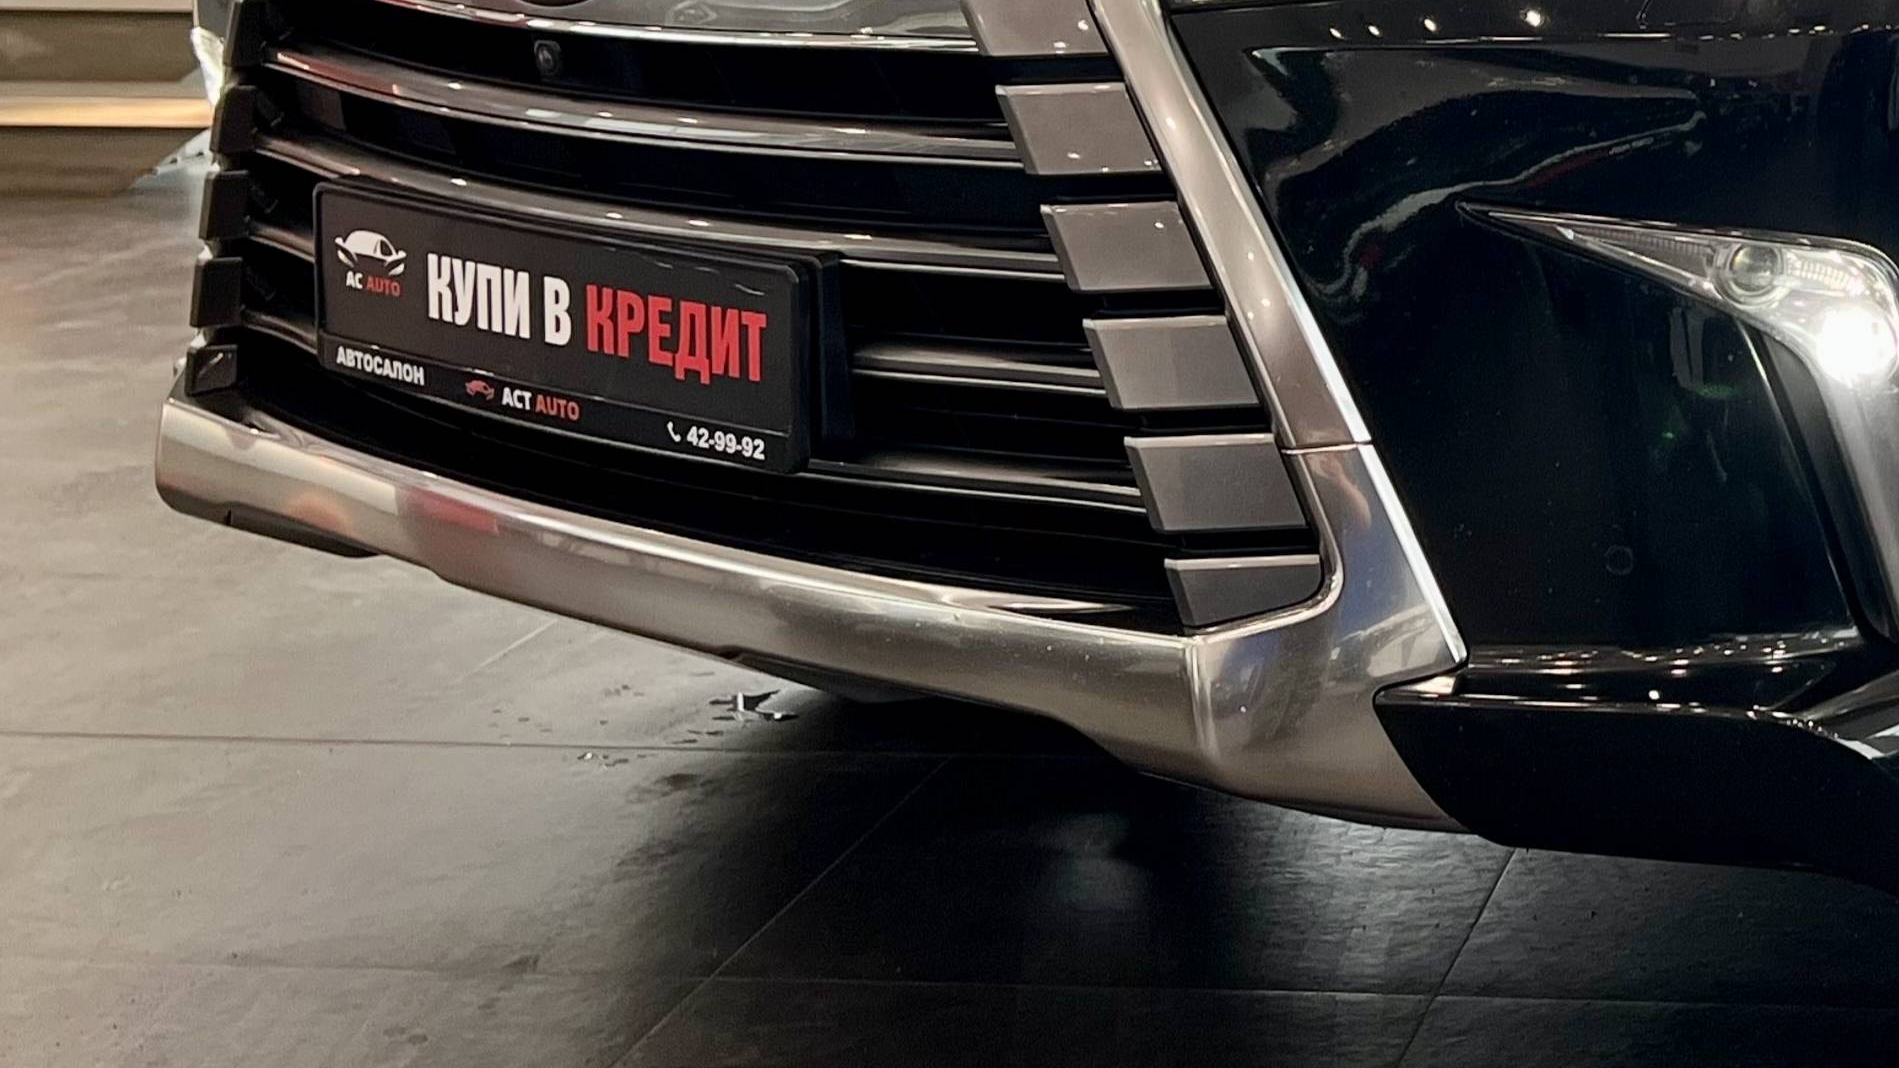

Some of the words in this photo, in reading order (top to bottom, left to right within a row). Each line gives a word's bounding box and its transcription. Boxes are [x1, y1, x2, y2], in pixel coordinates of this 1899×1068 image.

[345, 270, 363, 289] AC
[366, 276, 401, 297] AUTO
[427, 253, 530, 339] КУПИ
[543, 276, 571, 346] В
[586, 284, 767, 384] КРЕДИТ
[336, 345, 425, 386] АВТОСАЛОН
[502, 387, 532, 410] ACT
[536, 394, 580, 420] AUTO
[686, 427, 765, 460] 42-99-92
